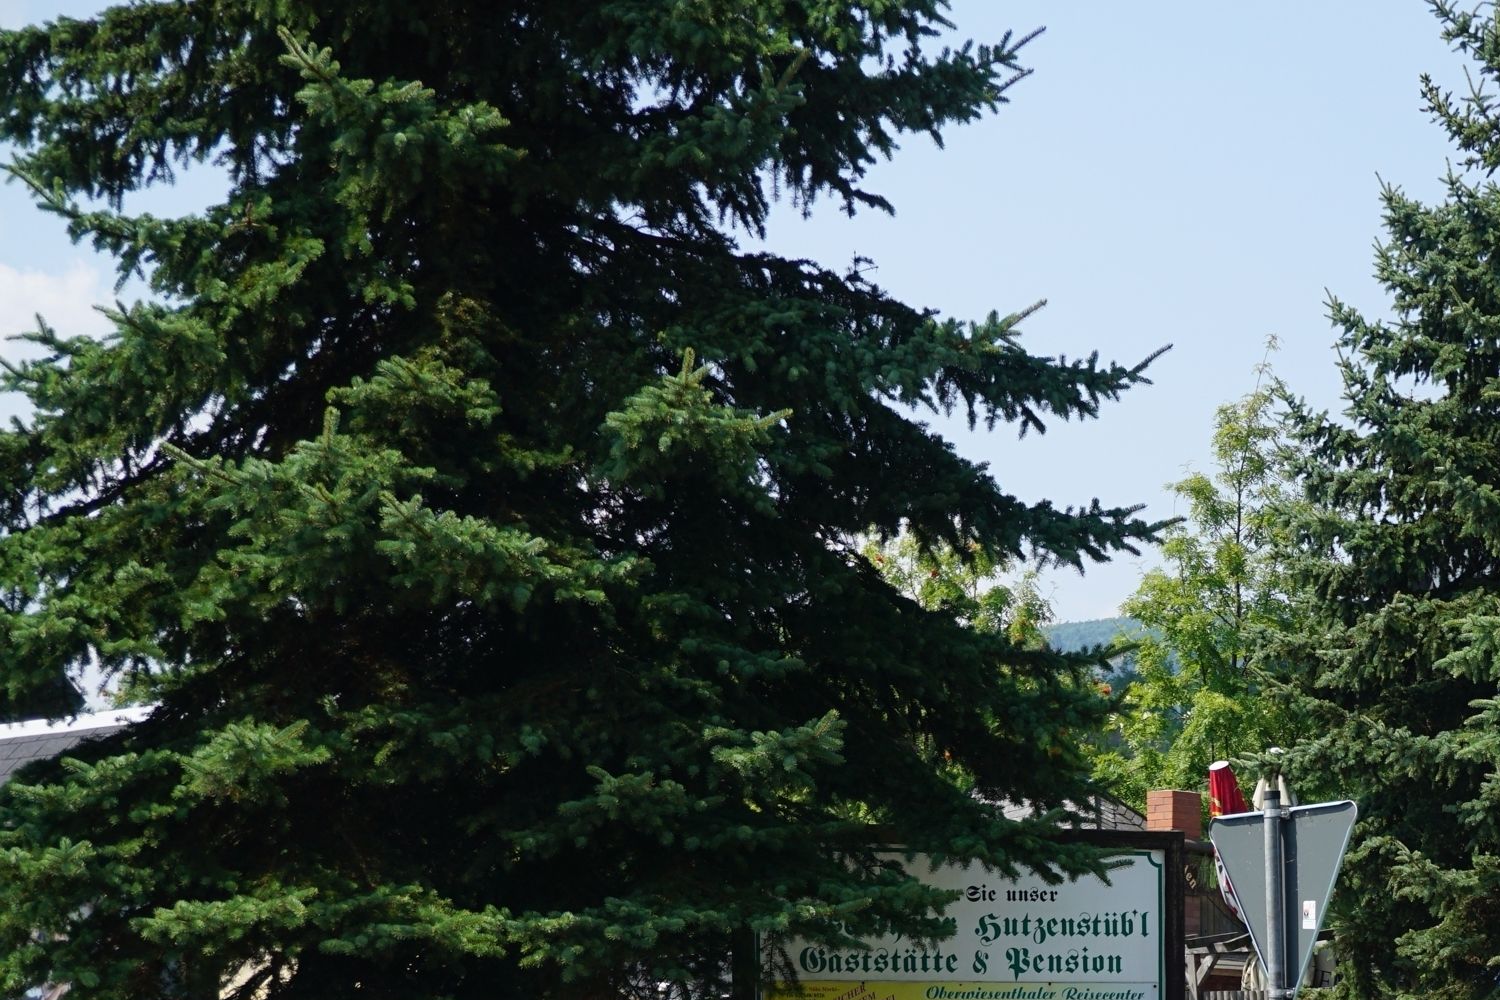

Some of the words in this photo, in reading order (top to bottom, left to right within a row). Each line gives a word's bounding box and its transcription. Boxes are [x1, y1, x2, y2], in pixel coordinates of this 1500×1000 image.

[966, 884, 1004, 902] Sie
[1007, 889, 1058, 903] unser
[975, 909, 1149, 946] Hutzenstüb'l
[800, 946, 959, 974] Gaststätte
[973, 950, 989, 975] &
[1006, 946, 1123, 981] Pension
[926, 985, 1057, 1000] Oberwiesenthaler
[1061, 986, 1145, 1000] Reisecenter
